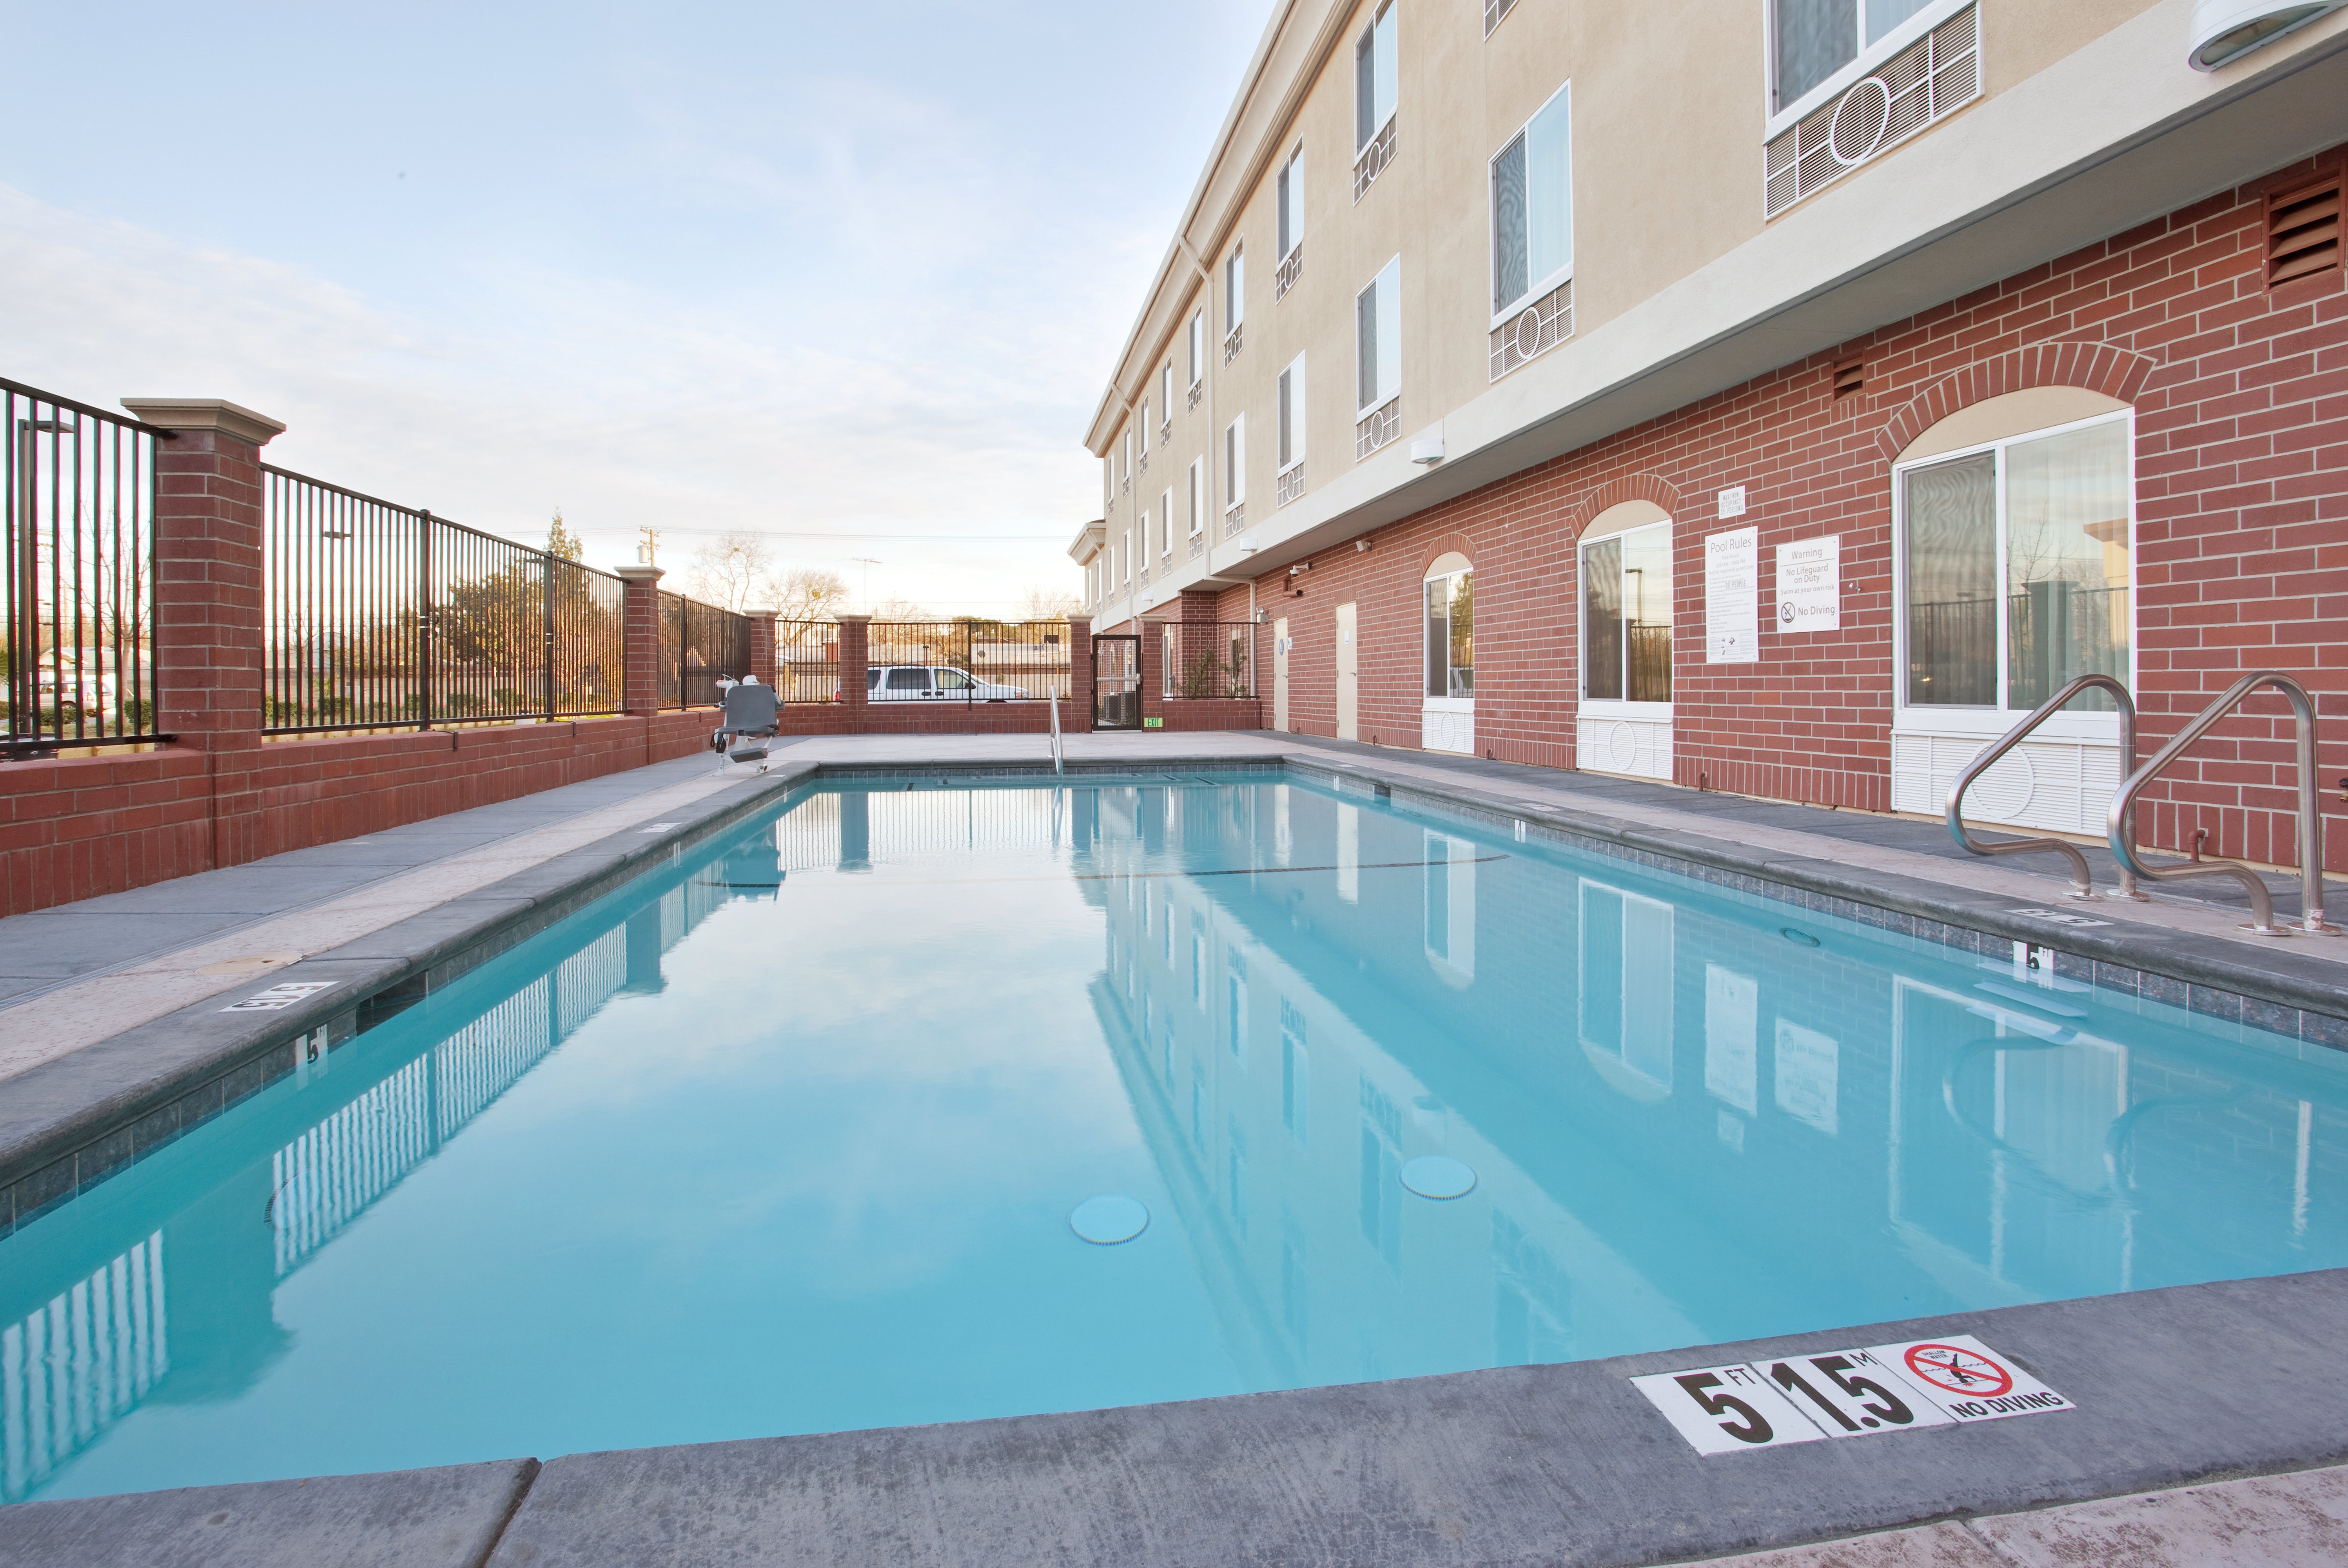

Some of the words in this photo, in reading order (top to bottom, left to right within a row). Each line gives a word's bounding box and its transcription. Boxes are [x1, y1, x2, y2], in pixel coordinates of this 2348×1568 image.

[1723, 492, 1739, 501] MAXIMUM
[1721, 498, 1741, 508] OCCUPANCY
[1727, 504, 1743, 514] PERSONS
[1711, 539, 1727, 554] Pool
[1729, 537, 1751, 550] Rules
[1791, 548, 1822, 560] Warning
[1797, 563, 1828, 575] Lifeguard
[1732, 580, 1746, 588] PEOPLE
[1804, 575, 1820, 583] Duty
[1798, 607, 1808, 616] No
[1811, 606, 1835, 616] Diving
[1147, 718, 1159, 726] EXIT
[2026, 943, 2040, 969] 5
[307, 1029, 319, 1064] 5
[1849, 1352, 1878, 1367] M
[1723, 1368, 1756, 1386] FT
[1770, 1356, 1914, 1432] 1.5
[1673, 1372, 1774, 1443] 5
[1948, 1401, 1989, 1418] NO
[1982, 1392, 2064, 1413] DIVING
